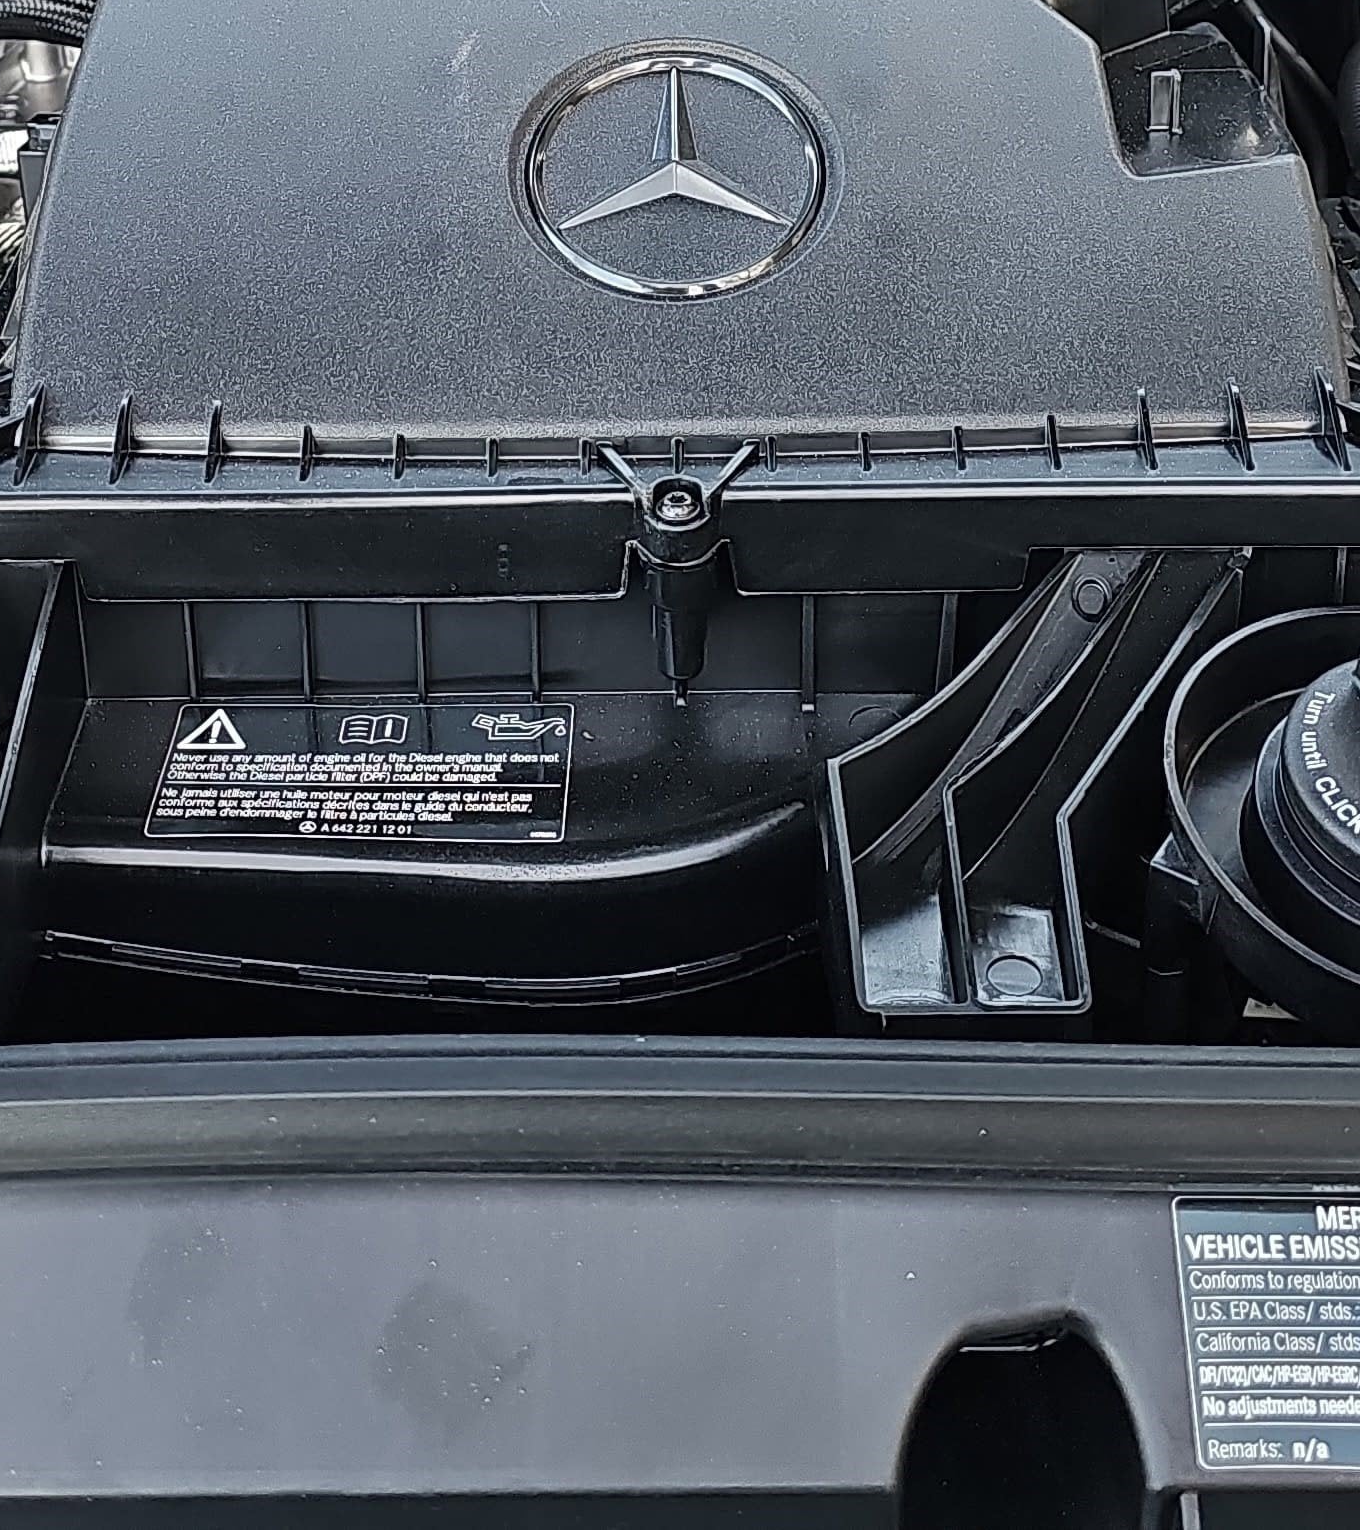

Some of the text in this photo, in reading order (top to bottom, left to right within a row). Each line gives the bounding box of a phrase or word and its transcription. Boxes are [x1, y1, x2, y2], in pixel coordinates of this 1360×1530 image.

[1302, 690, 1336, 725] Turn
[1300, 730, 1328, 770] until
[321, 824, 330, 833] A
[355, 825, 377, 834] 221
[1185, 1234, 1287, 1260] VEHICLE
[1190, 1271, 1264, 1290] Conforms
[1268, 1272, 1283, 1289] to
[1193, 1301, 1227, 1320] U.S.
[1230, 1301, 1259, 1320] EPA
[1263, 1301, 1314, 1322] Class/
[1196, 1332, 1270, 1352] California
[1273, 1332, 1324, 1354] Class/
[1202, 1396, 1225, 1415] No
[1228, 1396, 1317, 1419] adjustments
[1207, 1438, 1330, 1462] Remarks: n/a
